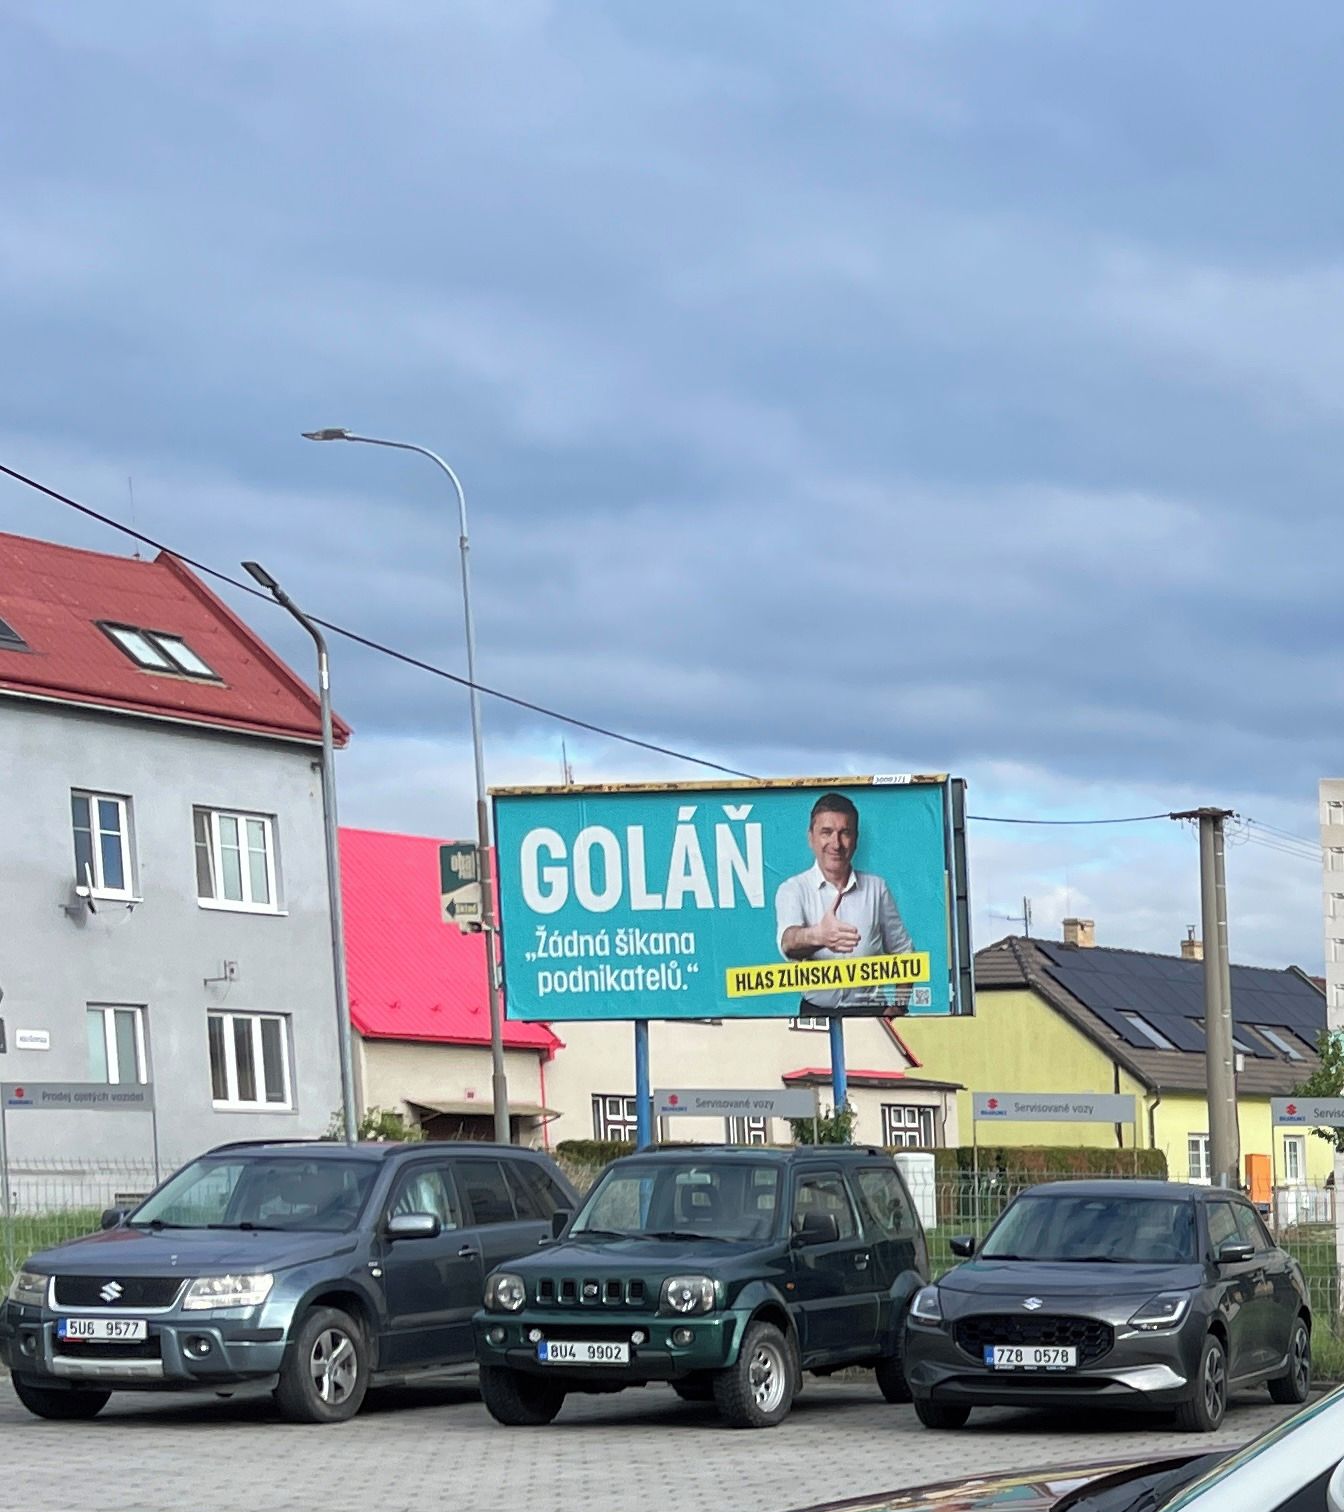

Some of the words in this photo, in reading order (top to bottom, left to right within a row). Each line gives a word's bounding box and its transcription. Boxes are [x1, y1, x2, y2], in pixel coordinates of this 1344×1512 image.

[519, 804, 766, 915] GOLÁŇ
[525, 925, 611, 962] „Žádná
[615, 929, 696, 956] šikana
[537, 960, 700, 997] podnikatelů.“
[735, 970, 774, 992] HLAS
[778, 964, 843, 988] ZLÍNSKA
[846, 964, 857, 982] V
[860, 956, 922, 980] SENÁTU
[695, 1096, 750, 1109] Servisované
[753, 1100, 774, 1111] vozy
[1014, 1102, 1069, 1113] Servisované
[1073, 1104, 1094, 1115] vozy
[106, 1321, 139, 1336] 9577
[550, 1344, 576, 1358] 8U4
[587, 1345, 622, 1360] 9902
[997, 1348, 1023, 1363] 7Z8
[1034, 1349, 1069, 1364] 0578
